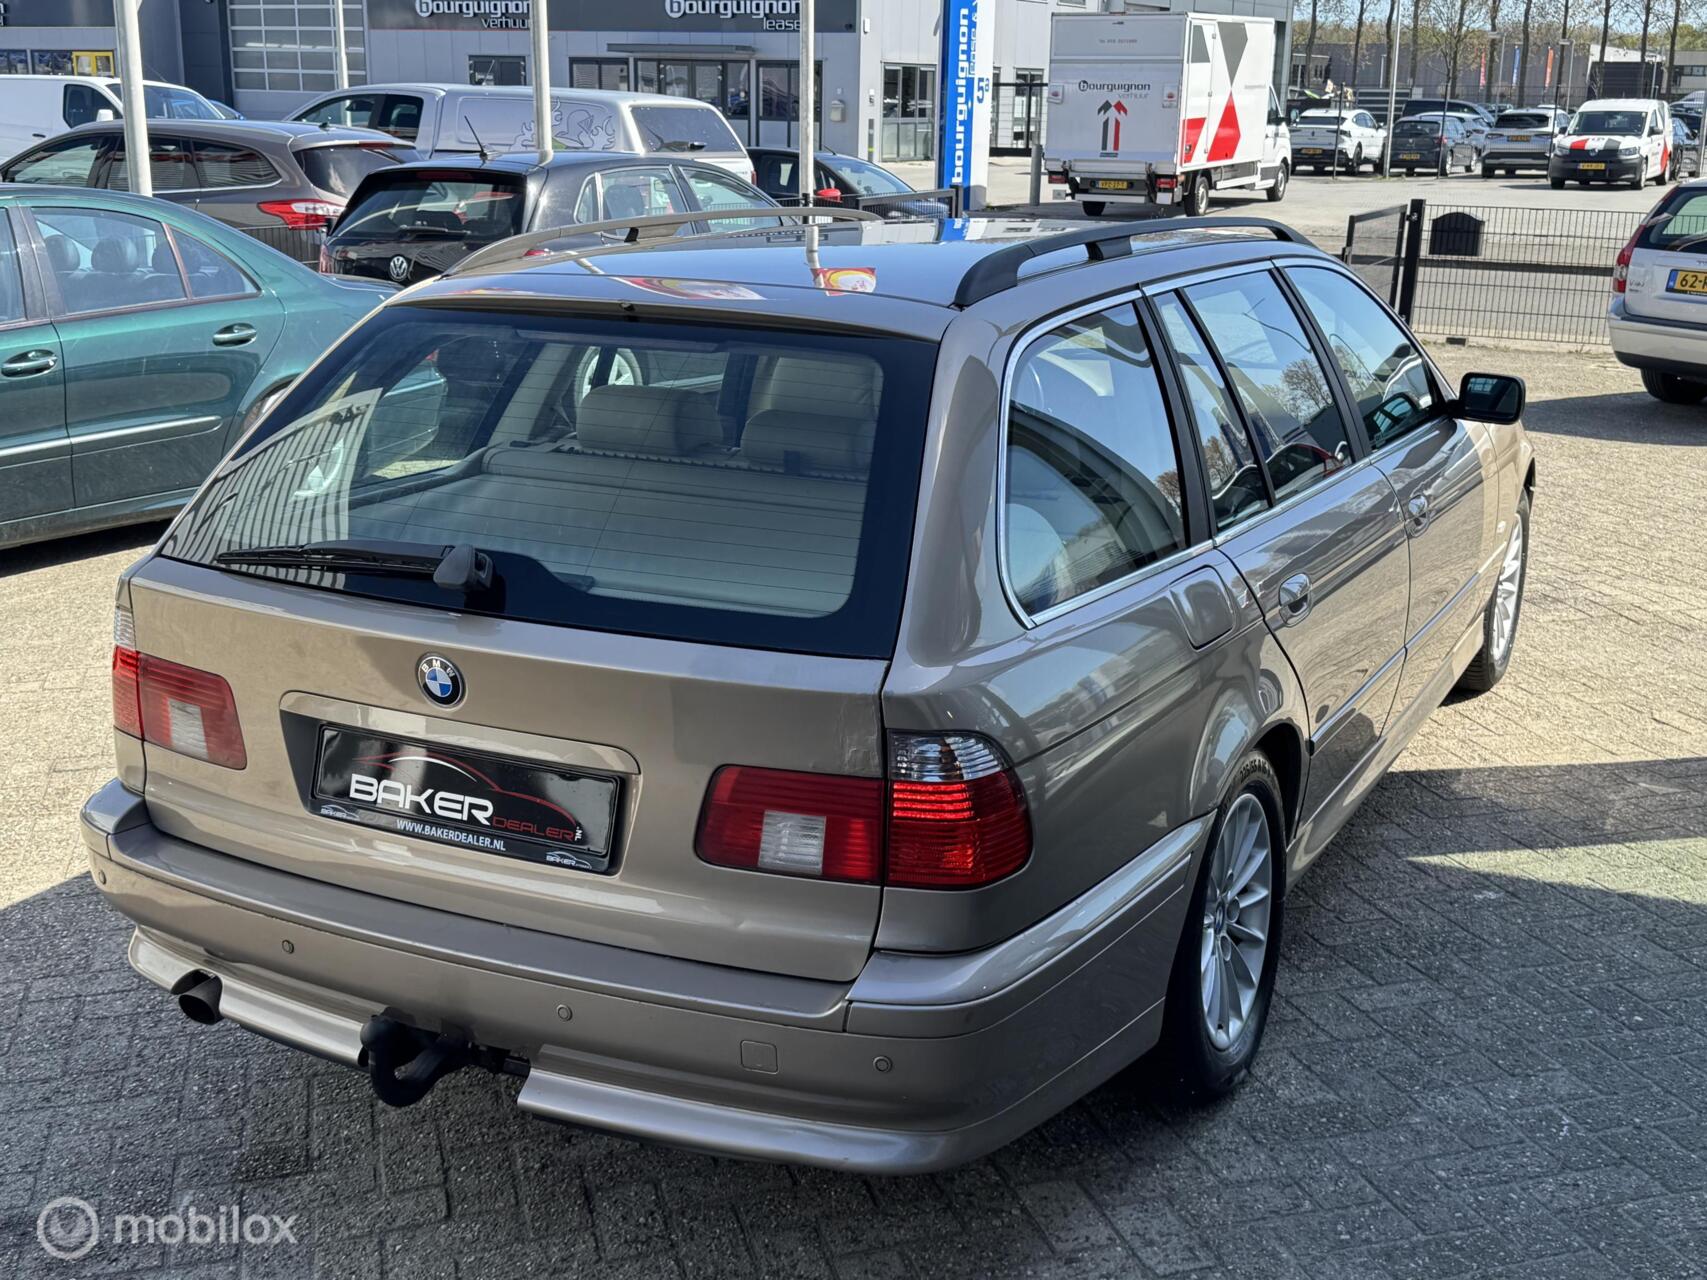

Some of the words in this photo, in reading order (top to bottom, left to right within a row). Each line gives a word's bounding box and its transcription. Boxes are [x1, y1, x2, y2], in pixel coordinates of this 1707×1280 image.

[763, 17, 800, 30] lease
[951, 8, 969, 184] bourguignon
[1078, 80, 1150, 93] bourguignon
[349, 773, 495, 826] BAKER
[396, 819, 506, 851] WWW.BAKERDEALER.NL
[492, 816, 576, 842] DEALER
